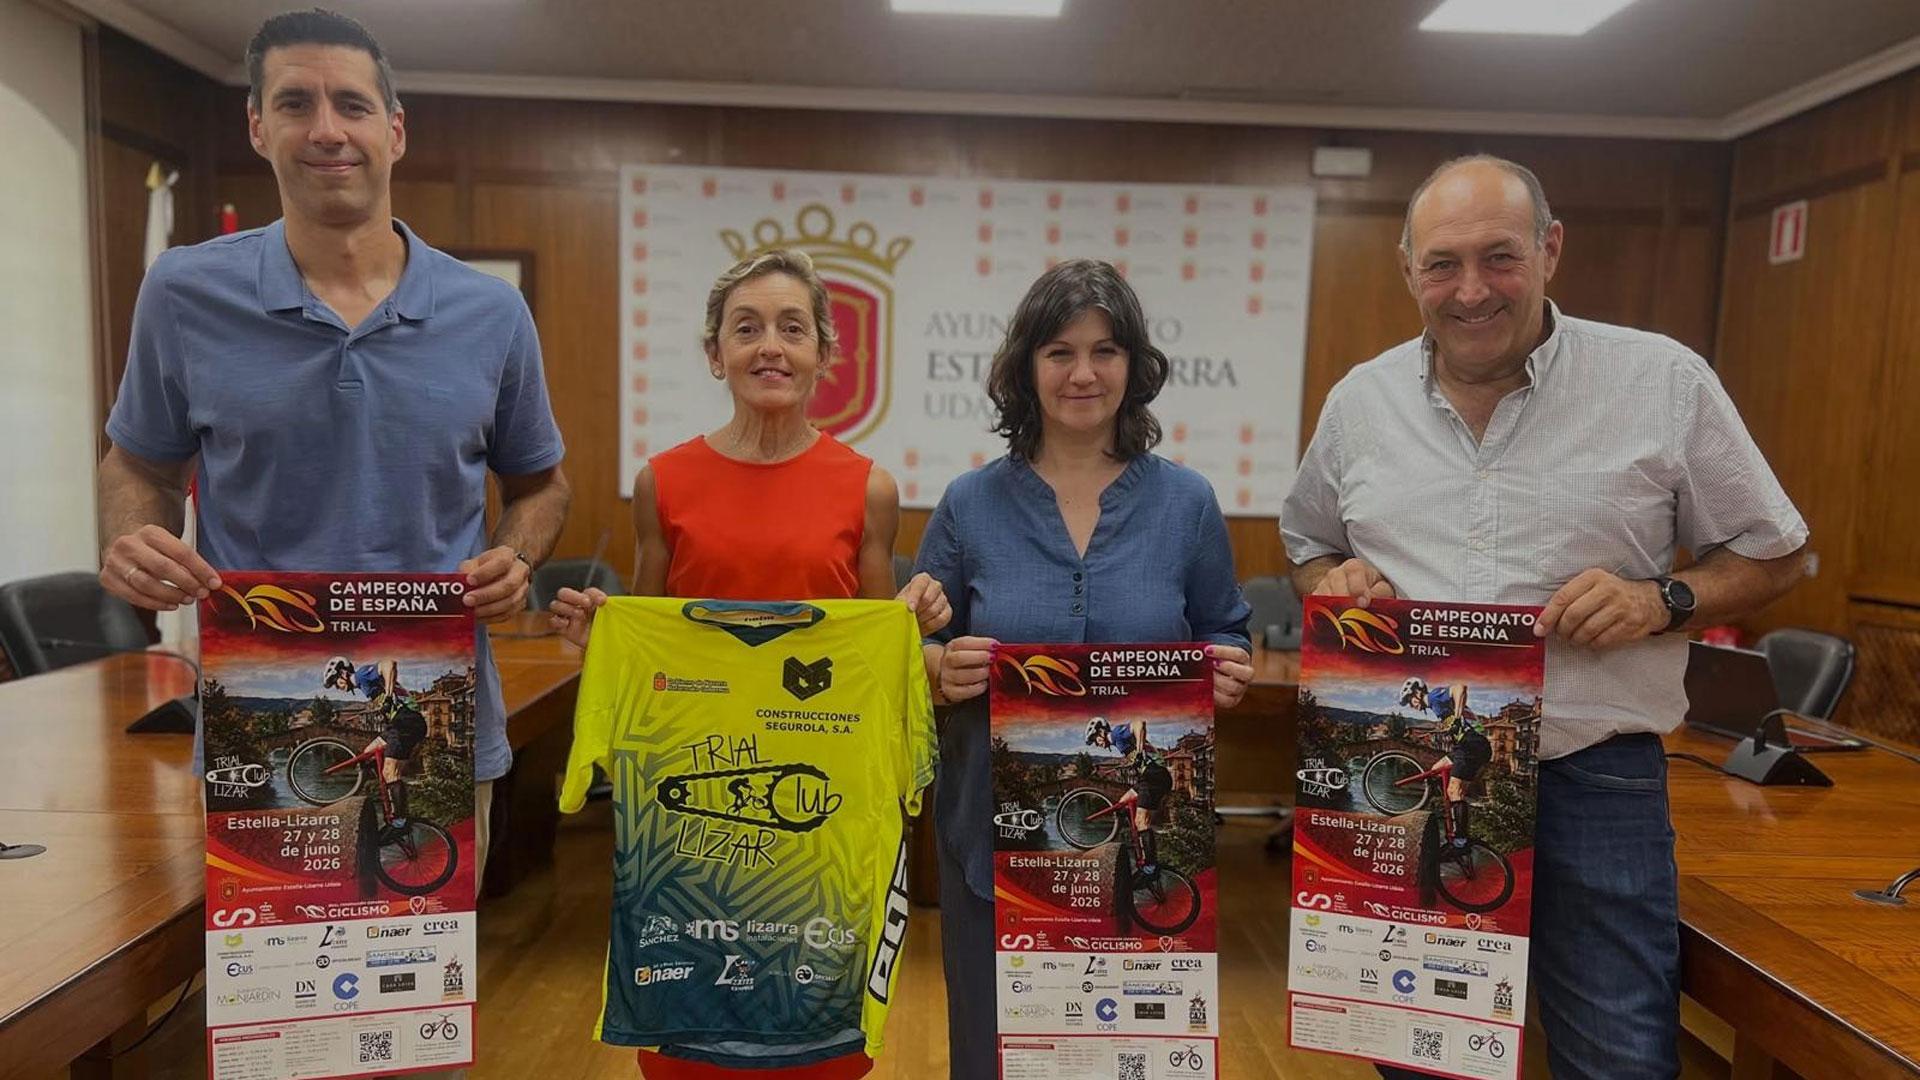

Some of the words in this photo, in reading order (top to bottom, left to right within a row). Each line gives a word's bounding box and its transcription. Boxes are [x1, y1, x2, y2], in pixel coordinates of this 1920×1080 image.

[329, 581, 465, 596] CAMPEONATO
[330, 599, 353, 612] DE
[362, 596, 438, 612] ESPAÑA
[1409, 608, 1536, 626] CAMPEONATO
[330, 621, 376, 632] TRIAL
[1410, 624, 1432, 636] DE
[1438, 624, 1509, 641] ESPAÑA
[1090, 650, 1204, 663] CAMPEONATO
[1409, 644, 1450, 656] TRIAL
[1090, 665, 1112, 677] DE
[1116, 663, 1181, 677] ESPAÑA
[1091, 686, 1128, 695] TRIAL
[756, 709, 861, 722] CONSTRUCCIONES
[765, 721, 829, 735] SEGUROLA,
[832, 724, 853, 734] S.A.
[681, 734, 772, 771] TRIAL
[214, 755, 244, 769] TRIAL
[1305, 758, 1326, 769] TRIAL
[214, 784, 249, 799] LIZAR
[1302, 784, 1331, 799] LIZAR
[1000, 801, 1021, 812] TRIAL
[227, 815, 340, 831] Estella-Lizarra
[1311, 814, 1406, 835] Estella-Lizarra
[283, 831, 300, 843] 27
[307, 832, 316, 843] y
[321, 829, 340, 841] 28
[1355, 834, 1371, 845] 27
[1376, 838, 1385, 849] y
[1389, 838, 1405, 849] 28
[674, 819, 777, 869] LIZAR
[281, 844, 299, 857] de
[303, 844, 340, 859] junio
[1353, 846, 1369, 858] de
[1372, 848, 1405, 863] junio
[303, 858, 340, 871] 2026
[1009, 857, 1100, 868] Estella-Lizarra
[1372, 862, 1405, 875] 2026
[1053, 872, 1067, 882] 27
[1072, 874, 1080, 883] y
[1085, 871, 1100, 881] 28
[1052, 883, 1066, 894] de
[1070, 884, 1100, 896] junio
[1070, 897, 1100, 908] 2026
[328, 905, 390, 918] CICLISMO
[1391, 911, 1447, 925] CICLISMO
[423, 920, 458, 932] crea
[746, 920, 798, 934] lizarra
[1091, 941, 1142, 951] CICLISMO
[1477, 938, 1511, 951] crea
[1171, 959, 1202, 968] crea
[1361, 968, 1378, 980] DN
[295, 980, 316, 993] DN
[1065, 1001, 1083, 1013] DN
